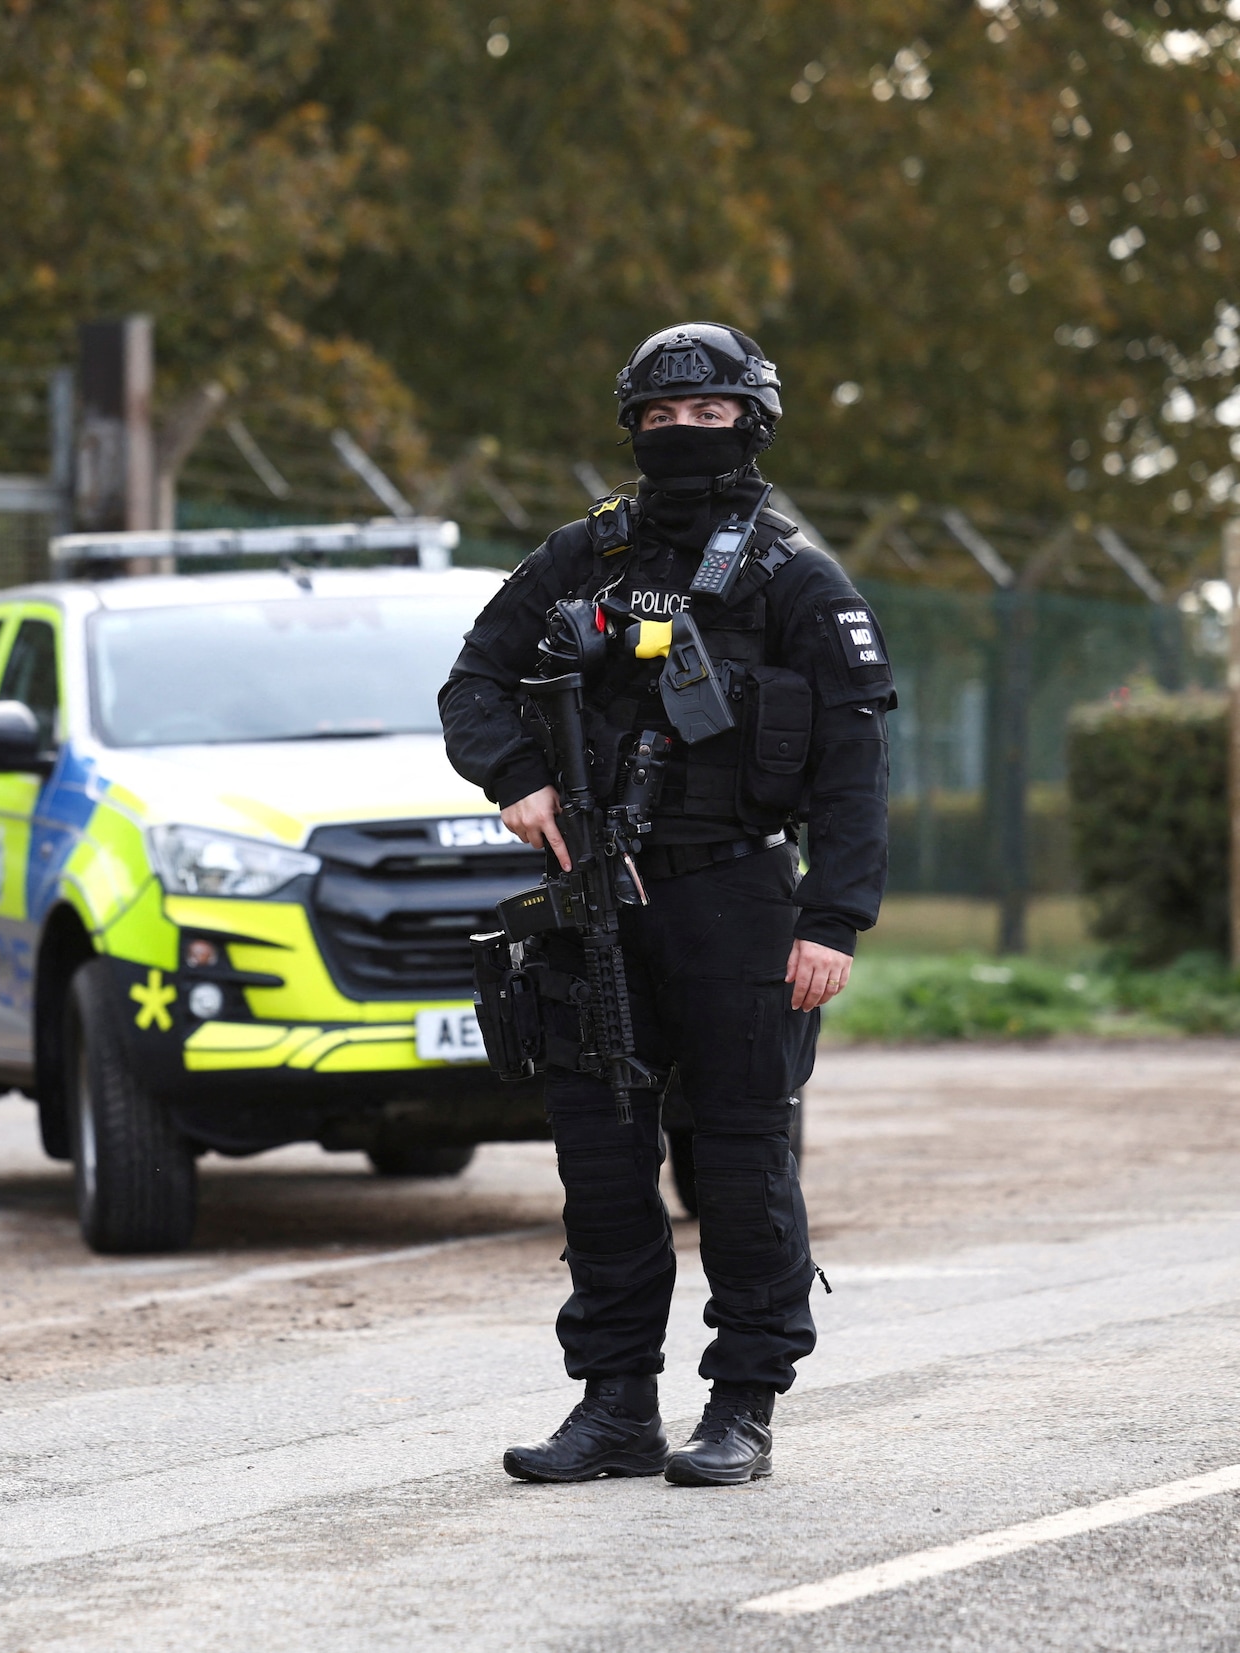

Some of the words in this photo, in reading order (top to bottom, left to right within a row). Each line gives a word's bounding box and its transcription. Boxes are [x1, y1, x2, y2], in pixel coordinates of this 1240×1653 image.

[628, 590, 692, 616] POLICE
[837, 611, 870, 624] POLICE
[850, 628, 872, 646] MD
[437, 818, 524, 847] ISU
